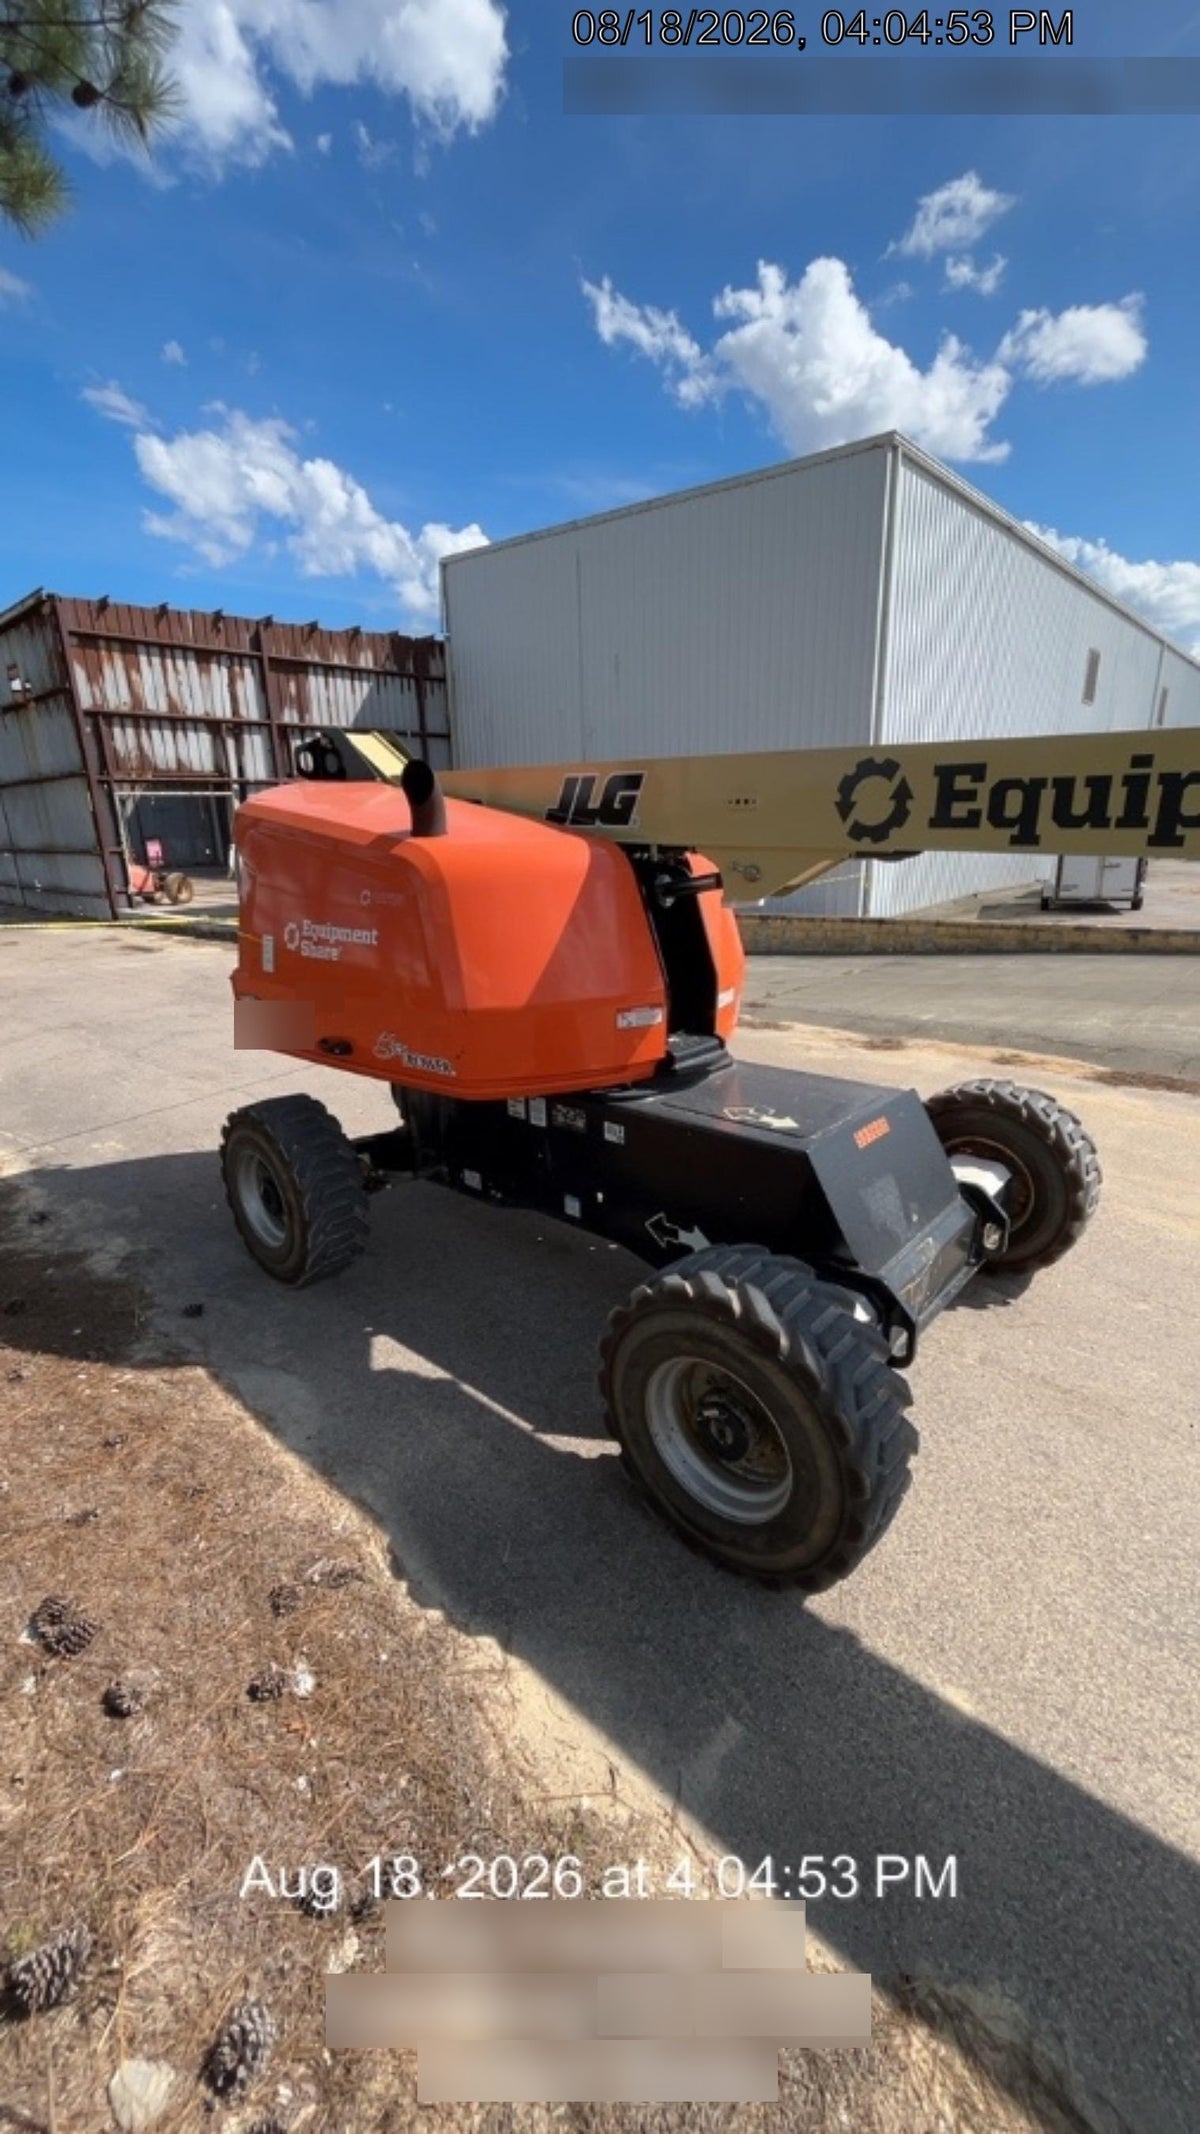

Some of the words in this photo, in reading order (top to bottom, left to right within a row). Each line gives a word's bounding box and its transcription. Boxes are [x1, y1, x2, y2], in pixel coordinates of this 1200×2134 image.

[545, 772, 644, 825] JLG
[303, 919, 378, 945] Equipment
[301, 940, 339, 961] Share
